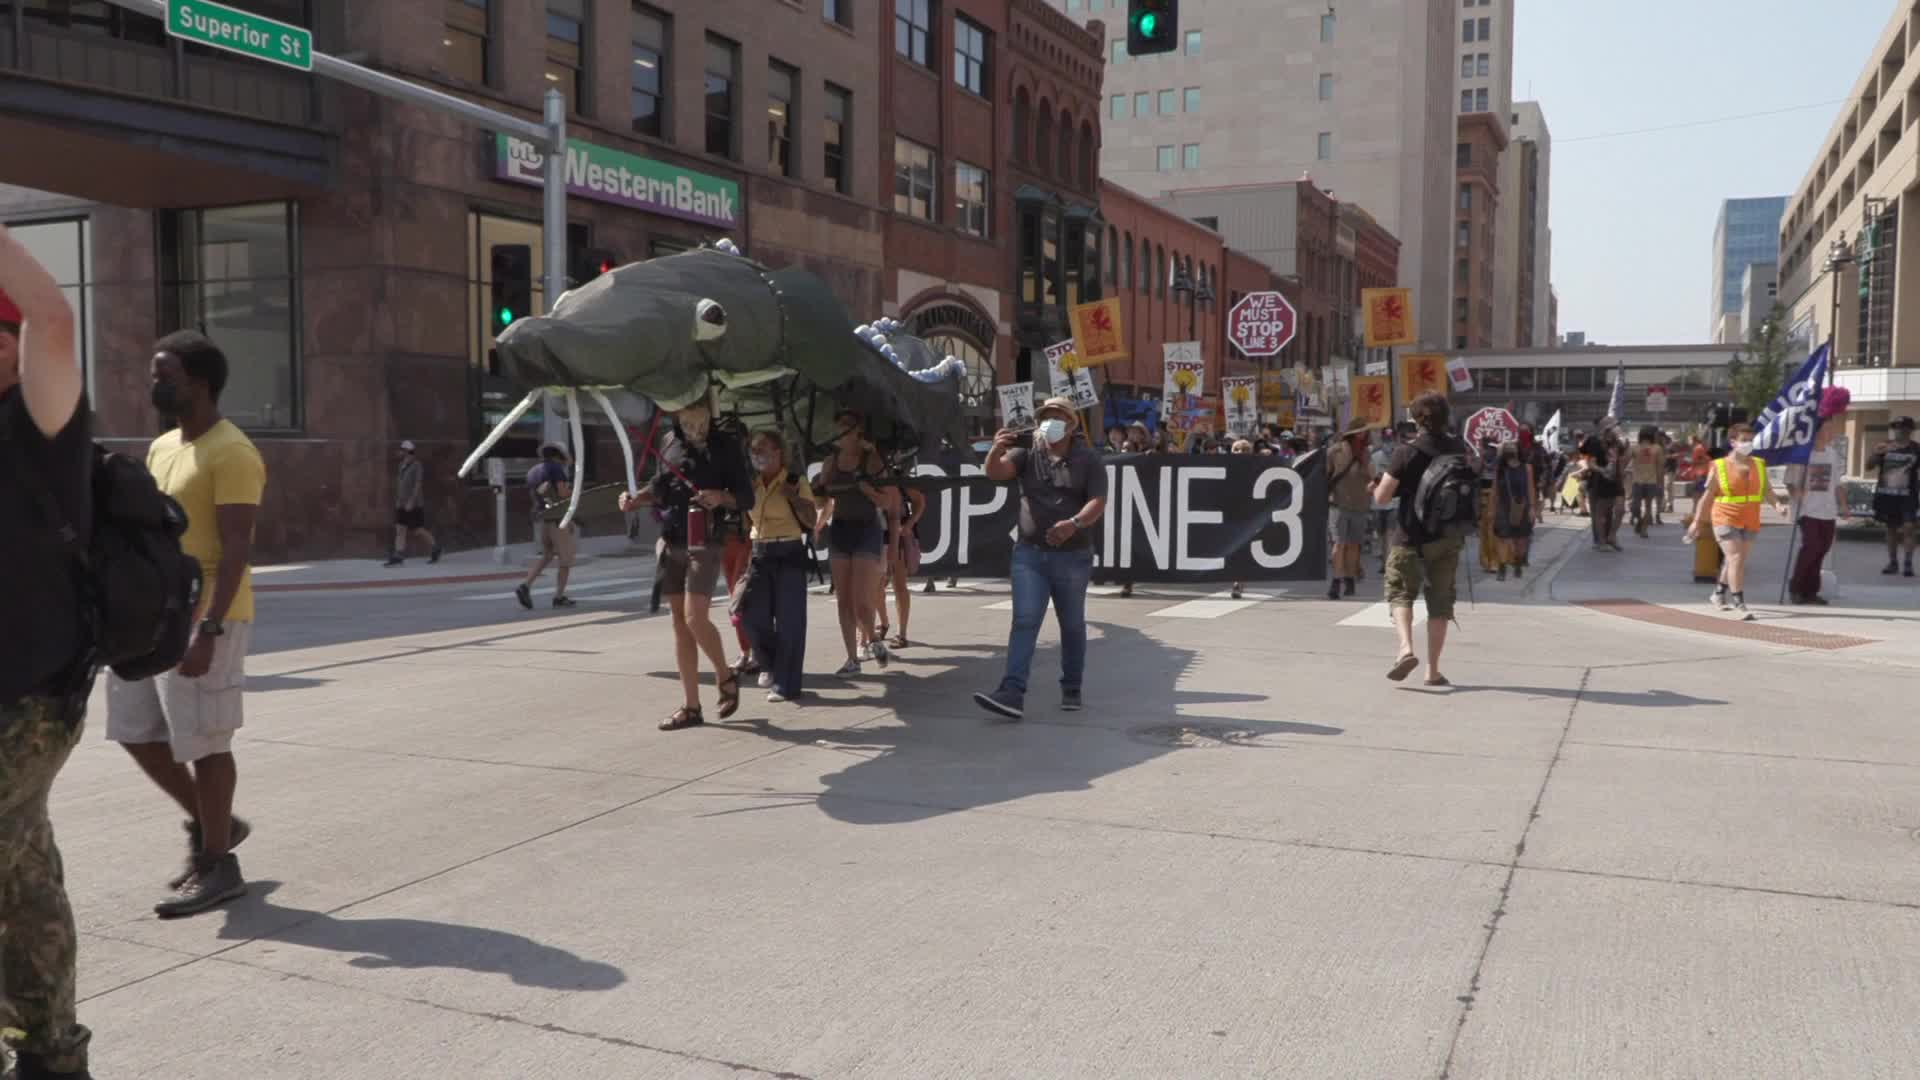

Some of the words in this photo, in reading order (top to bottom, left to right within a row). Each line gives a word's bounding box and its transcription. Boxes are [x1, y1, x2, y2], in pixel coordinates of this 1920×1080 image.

[180, 5, 269, 48] Superior
[280, 34, 302, 58] St
[1249, 295, 1276, 308] WE
[1240, 308, 1282, 321] MUST
[1237, 321, 1284, 338] STOP
[1243, 337, 1266, 348] LINE
[1270, 337, 1278, 348] 3
[1047, 343, 1073, 358] STO
[1167, 361, 1202, 371] STOP
[1093, 465, 1226, 570] INE
[1250, 467, 1304, 569] 3
